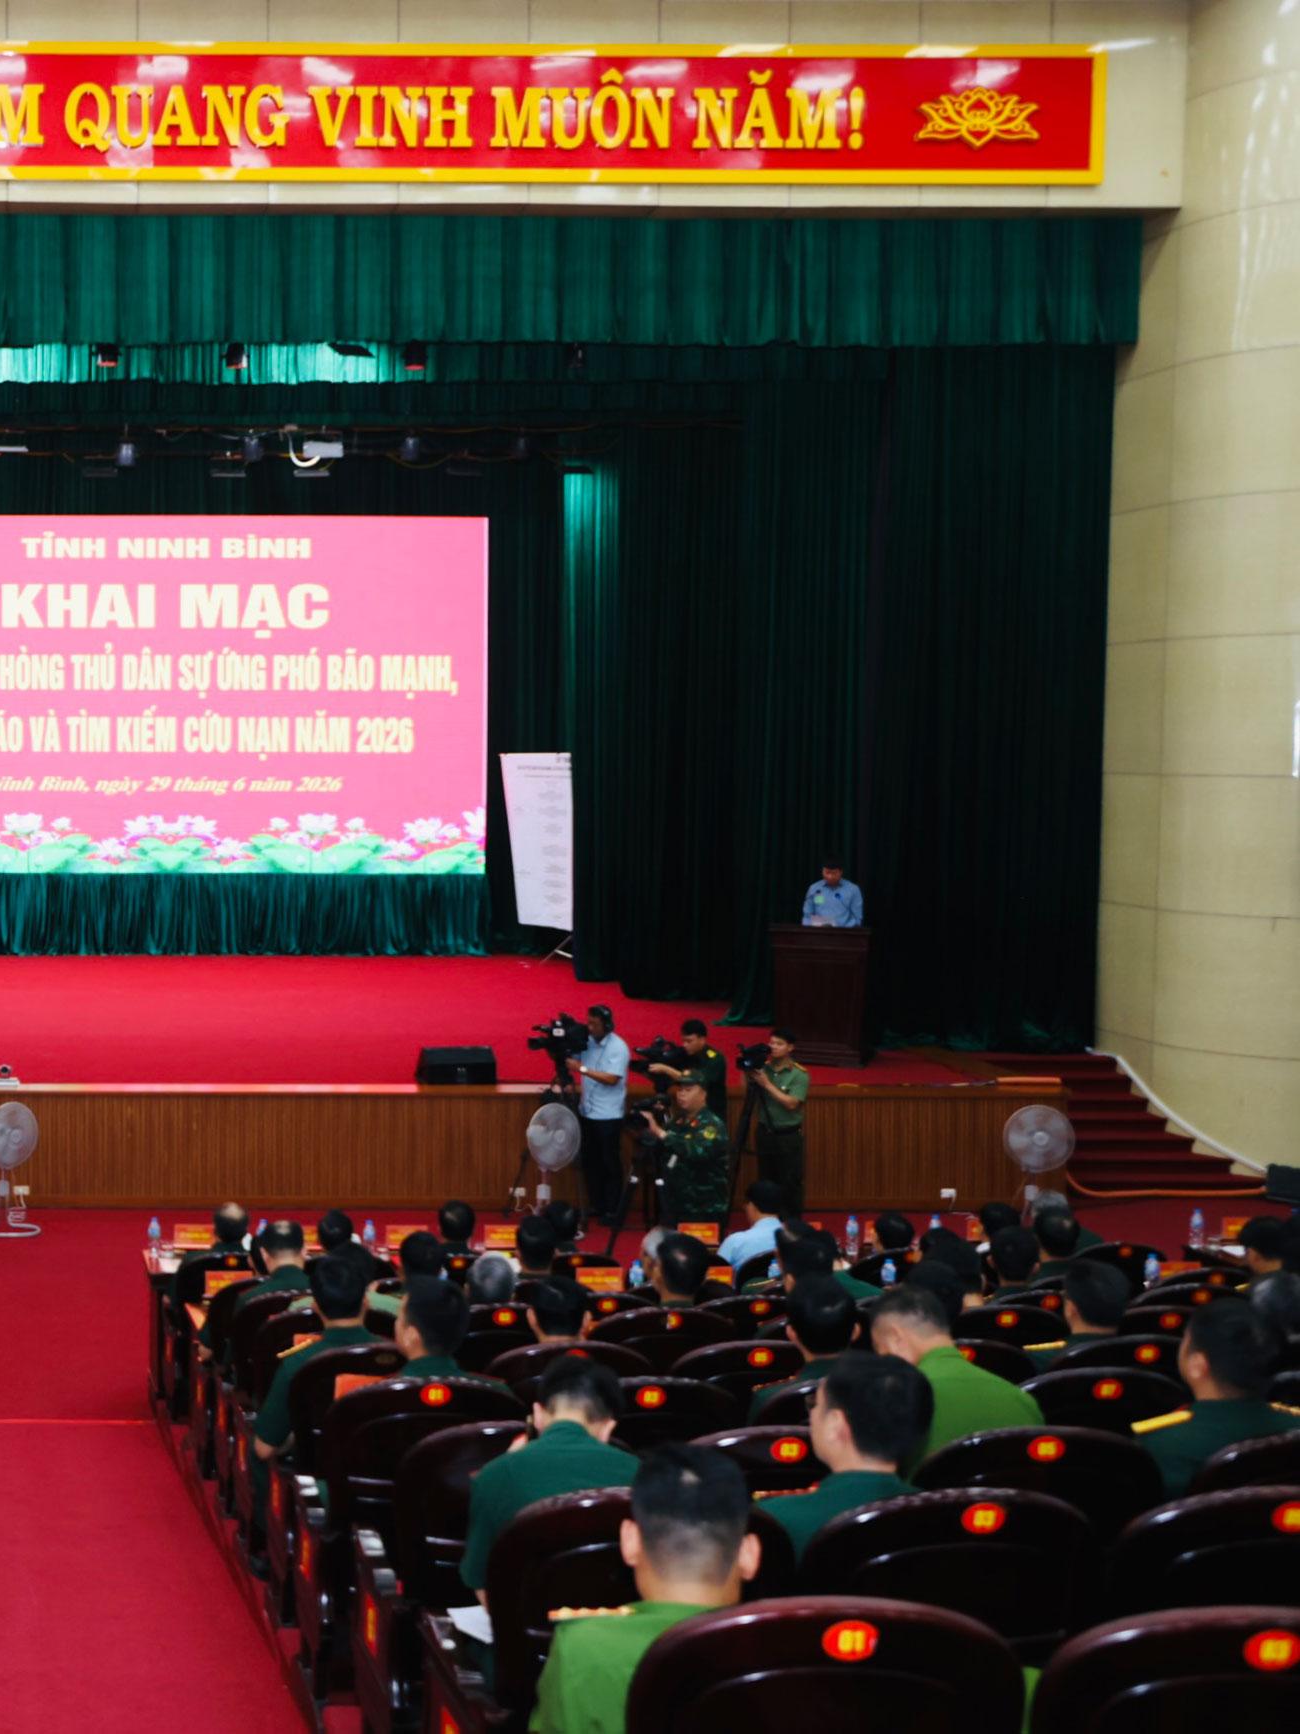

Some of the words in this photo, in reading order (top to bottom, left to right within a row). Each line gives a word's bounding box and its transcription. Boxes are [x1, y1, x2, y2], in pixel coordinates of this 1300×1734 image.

[64, 83, 287, 152] QUANG
[308, 84, 473, 149] VINH
[490, 67, 674, 149] MUÔN
[693, 68, 866, 150] NĂM!
[118, 537, 211, 559] NINH
[221, 533, 312, 559] BÌNH
[1, 583, 156, 629] KHAI
[179, 583, 330, 639] MẠC
[70, 641, 117, 691] THỦ
[121, 646, 173, 691] DÂN
[178, 650, 214, 699] SỰ
[216, 646, 267, 692] ỨNG
[272, 646, 321, 692] PHÓ
[326, 647, 375, 692] BÃO
[380, 654, 459, 700] MẠNH,
[28, 708, 62, 753] VÀ
[66, 708, 111, 753] TÌM
[116, 704, 178, 753] KIẾM
[182, 709, 233, 754] CỨU
[237, 716, 290, 761] NẠN
[294, 709, 351, 753] NĂM
[355, 716, 415, 754] 2026
[94, 775, 143, 796] ngày
[145, 775, 172, 793] 29
[173, 775, 229, 797] tháng
[231, 776, 247, 793] 6
[248, 776, 294, 793] năm
[295, 775, 343, 793] 2026
[837, 1629, 866, 1653] 01
